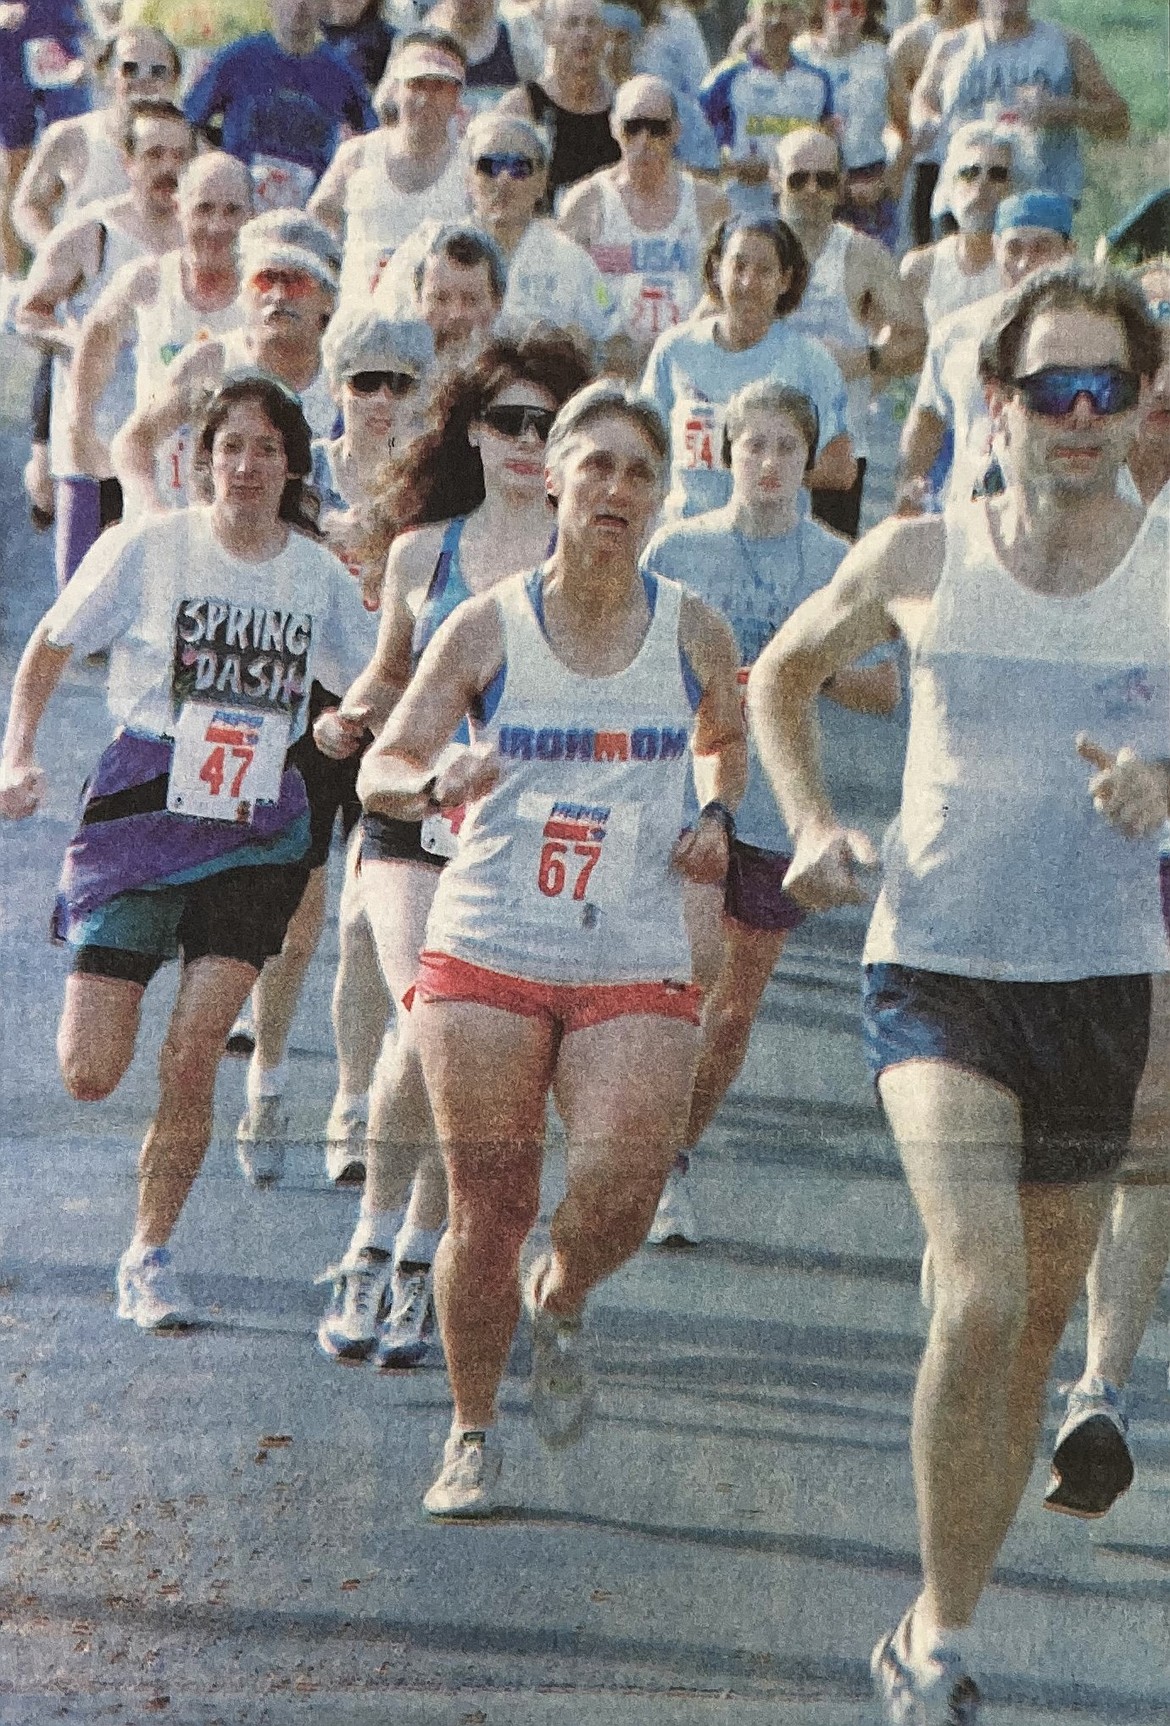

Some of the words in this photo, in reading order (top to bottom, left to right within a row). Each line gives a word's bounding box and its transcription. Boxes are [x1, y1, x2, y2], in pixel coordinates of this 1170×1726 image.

[178, 599, 311, 656] SPRING
[195, 648, 304, 703] DASH
[199, 746, 254, 798] 47
[538, 841, 602, 901] 67
